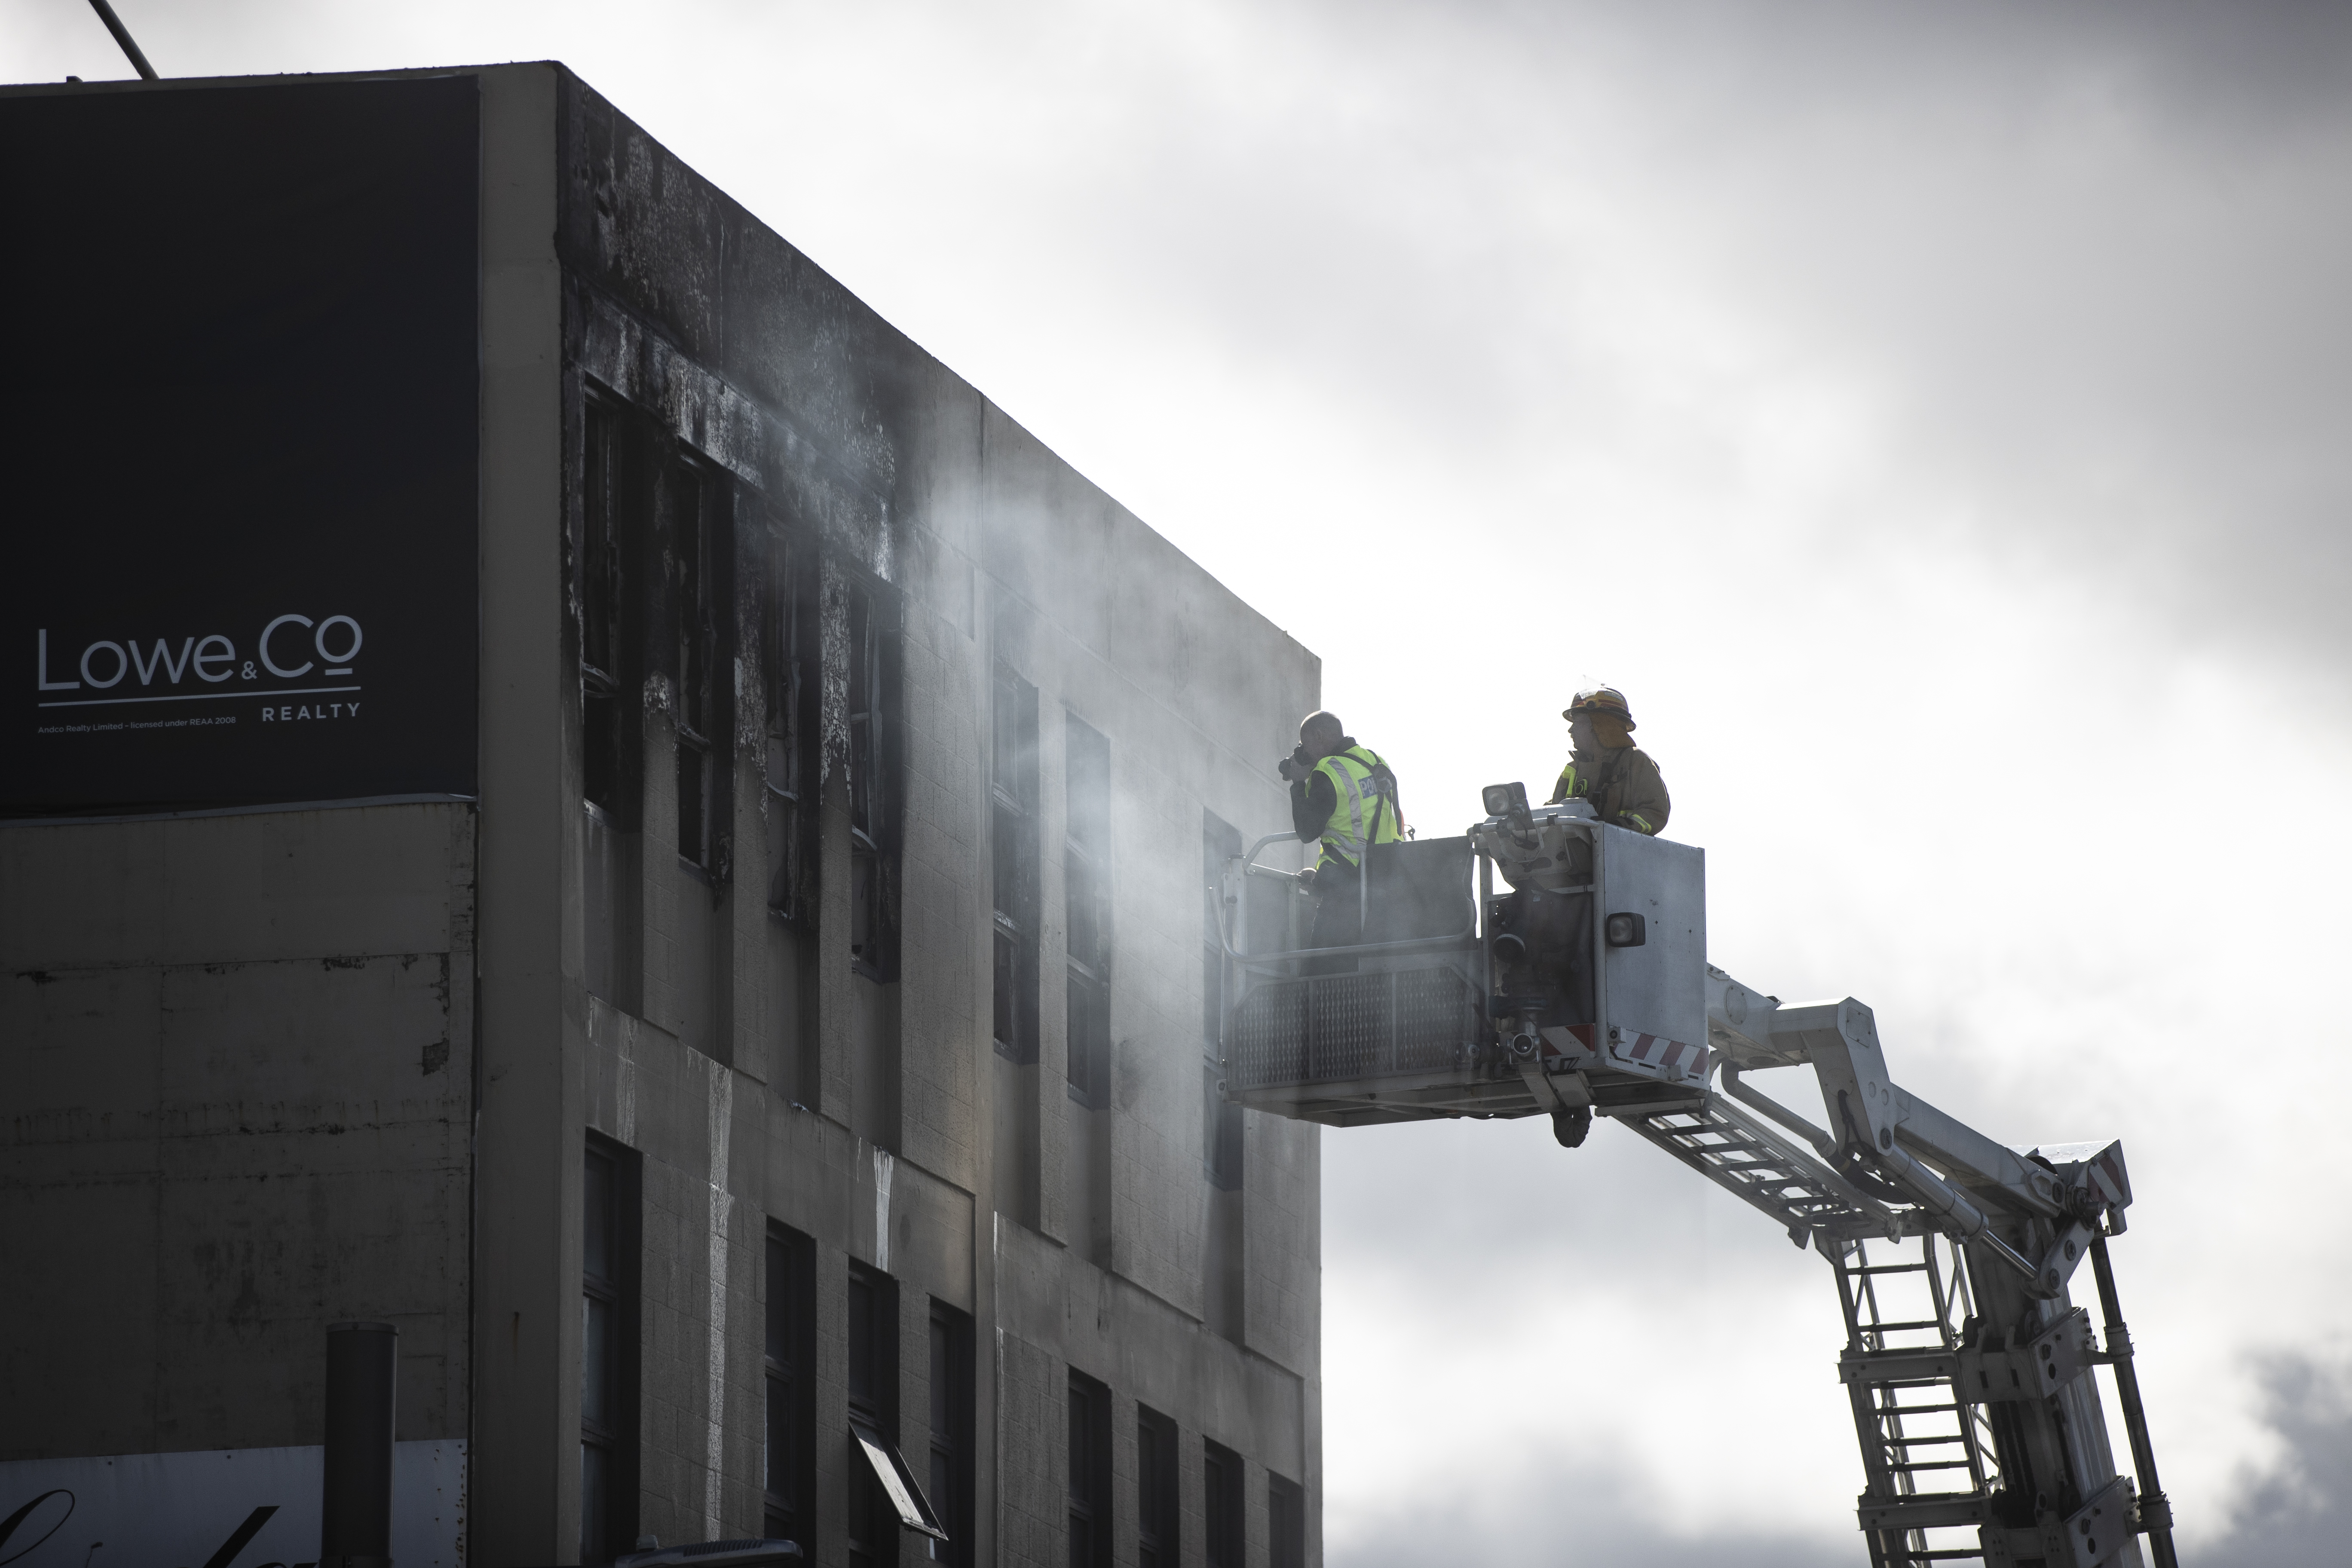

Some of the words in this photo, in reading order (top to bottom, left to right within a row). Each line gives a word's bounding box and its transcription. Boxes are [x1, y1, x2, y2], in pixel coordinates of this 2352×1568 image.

[262, 702, 361, 722] REALTY
[93, 723, 123, 731] Limited
[130, 720, 163, 729] licensed
